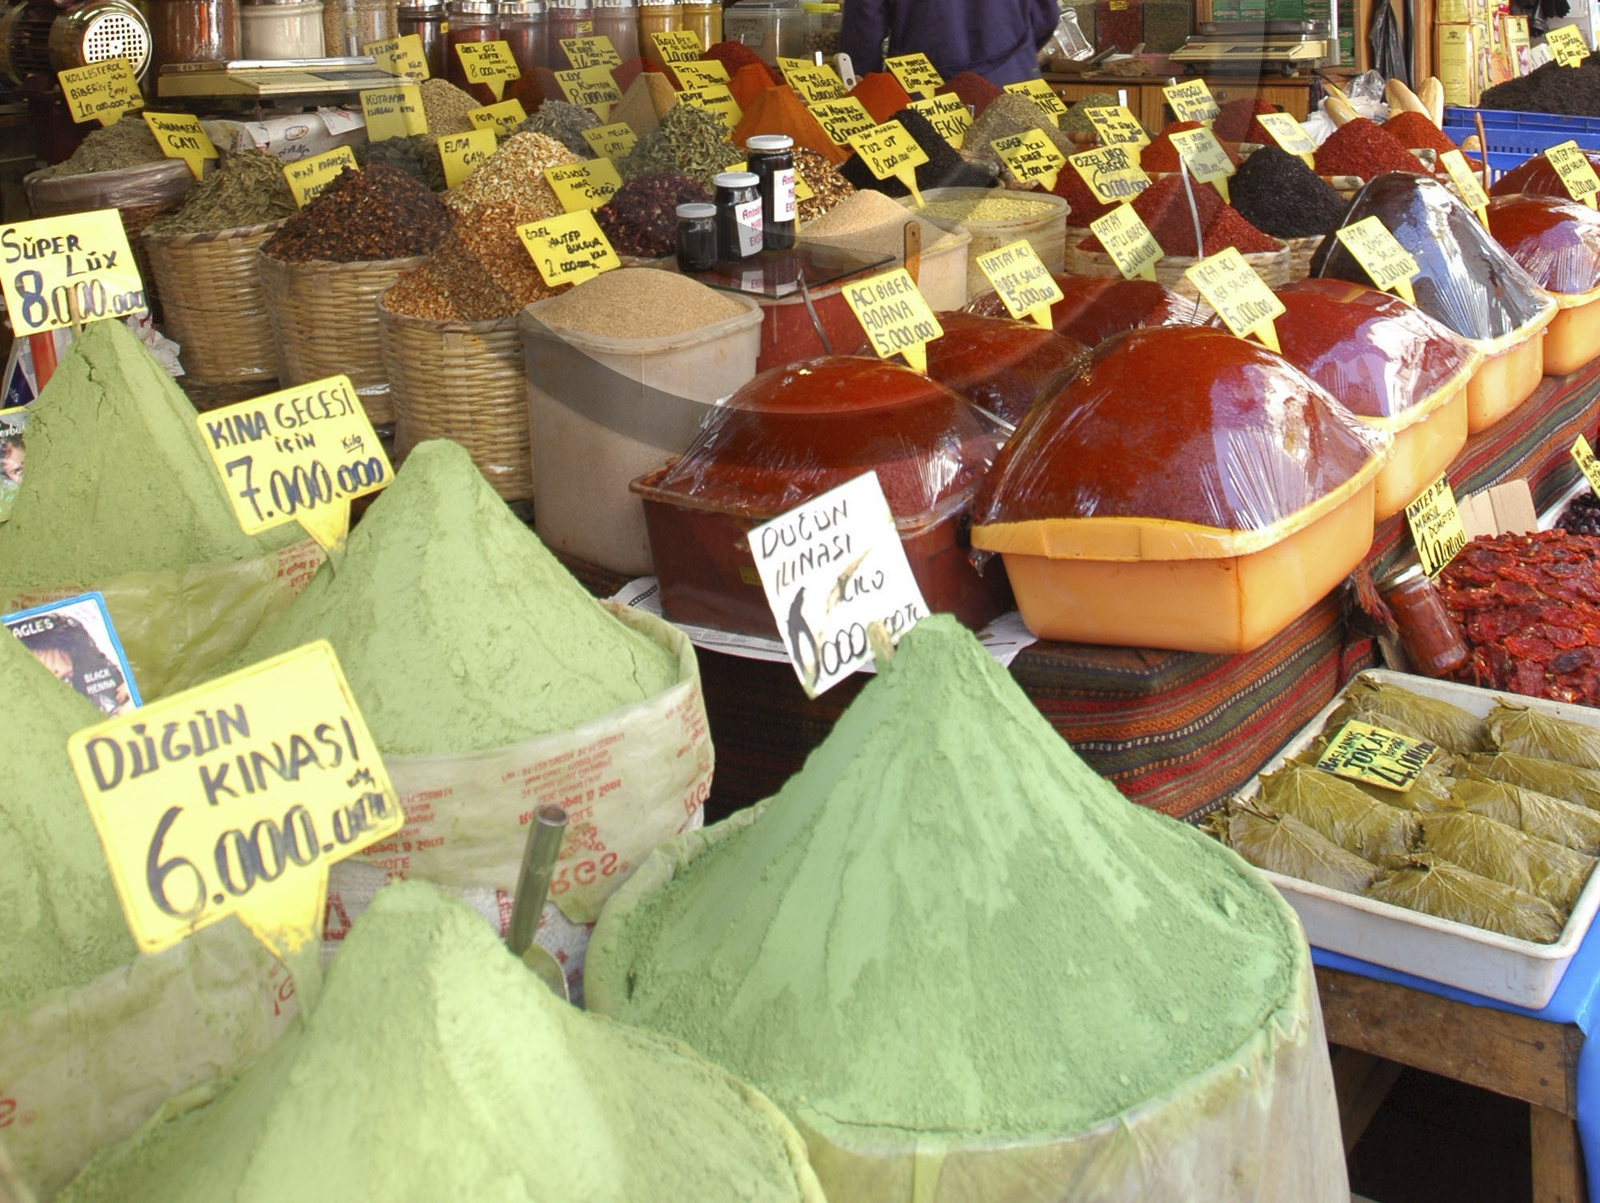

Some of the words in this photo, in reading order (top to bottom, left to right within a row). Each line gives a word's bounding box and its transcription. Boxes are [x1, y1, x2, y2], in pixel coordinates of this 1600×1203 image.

[929, 115, 969, 139] EKİK
[168, 135, 200, 150] ÇAYI
[444, 137, 471, 154] ELMA
[550, 230, 581, 248] ANTEP
[565, 237, 604, 255] BULGUR
[981, 250, 1015, 276] HATAY
[850, 285, 878, 310] ACI
[862, 299, 914, 332] ADANA
[206, 410, 271, 450] KINA
[274, 387, 356, 428] GECESİ
[224, 455, 385, 523] 7.000.000
[84, 668, 111, 684] BLACK
[86, 679, 116, 694] HENNA
[199, 716, 360, 807] KINASI
[1342, 729, 1392, 772] TOKAT
